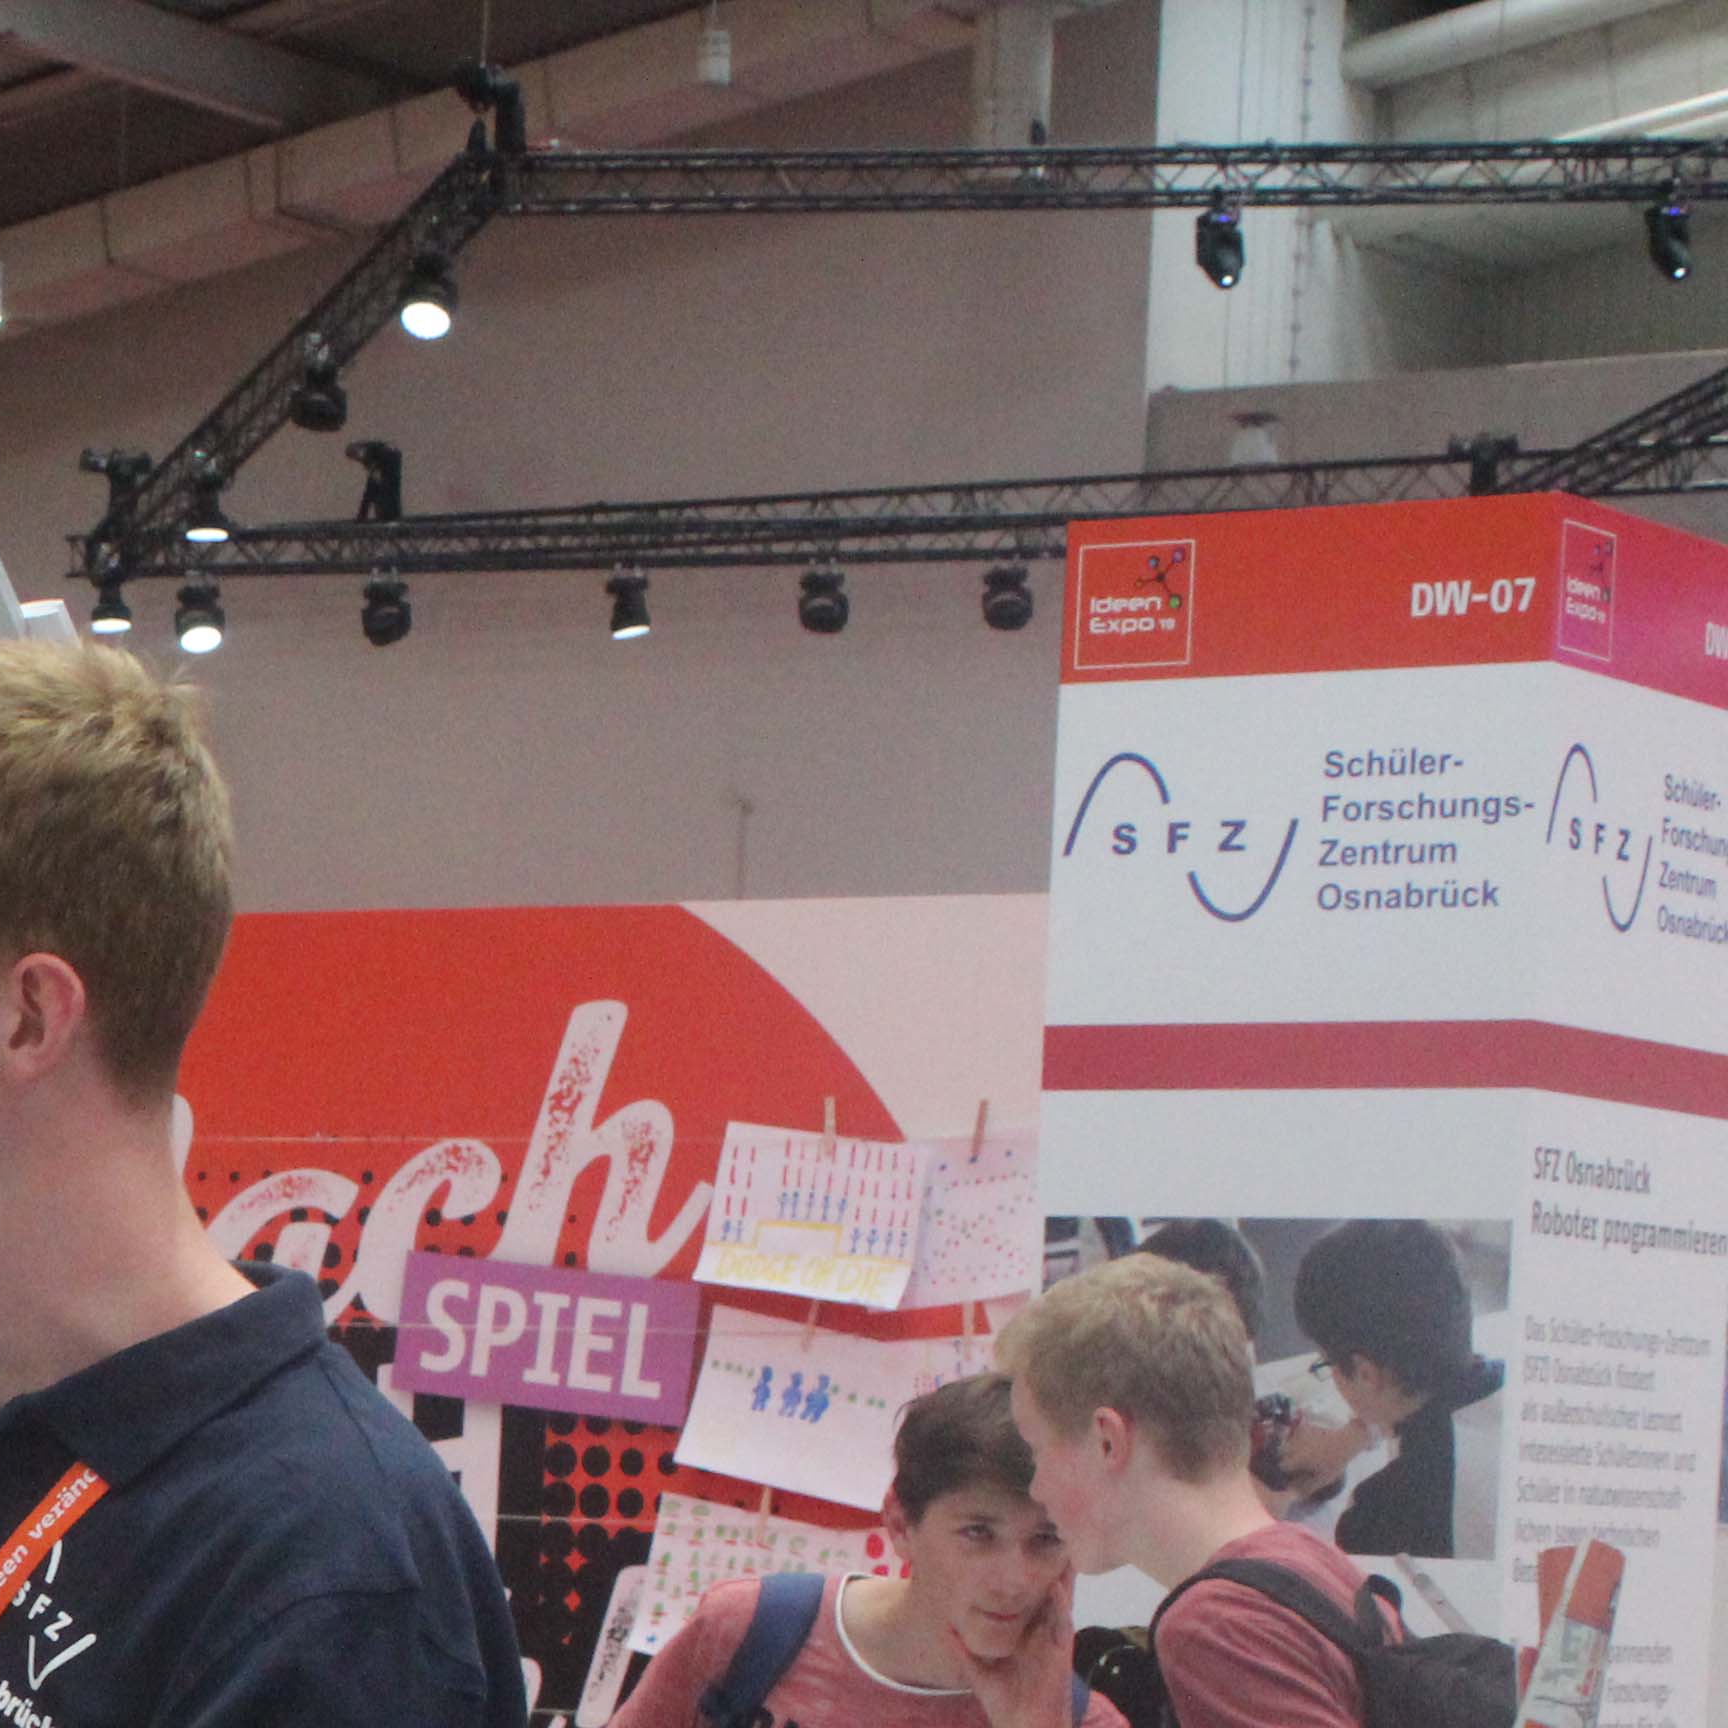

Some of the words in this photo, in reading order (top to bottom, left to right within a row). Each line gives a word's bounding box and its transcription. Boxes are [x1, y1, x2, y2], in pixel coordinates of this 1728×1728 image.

[1089, 592, 1162, 614] Ideen
[1410, 578, 1536, 619] DW-07
[1088, 614, 1155, 635] Expo
[1704, 622, 1728, 661] DW
[1324, 747, 1464, 779] Schüler-
[1322, 791, 1536, 829] Forschungs-
[1663, 773, 1721, 812] Schüler-
[1319, 838, 1457, 868] Zentrum
[1317, 879, 1499, 912] Osnabrück
[1659, 860, 1717, 898] Zentrum
[173, 1000, 714, 1326] ach
[1532, 1147, 1562, 1183] SFZ
[1566, 1151, 1651, 1194] Osnabrück
[1531, 1200, 1599, 1241] Roboter
[420, 1279, 662, 1399] SPIEL
